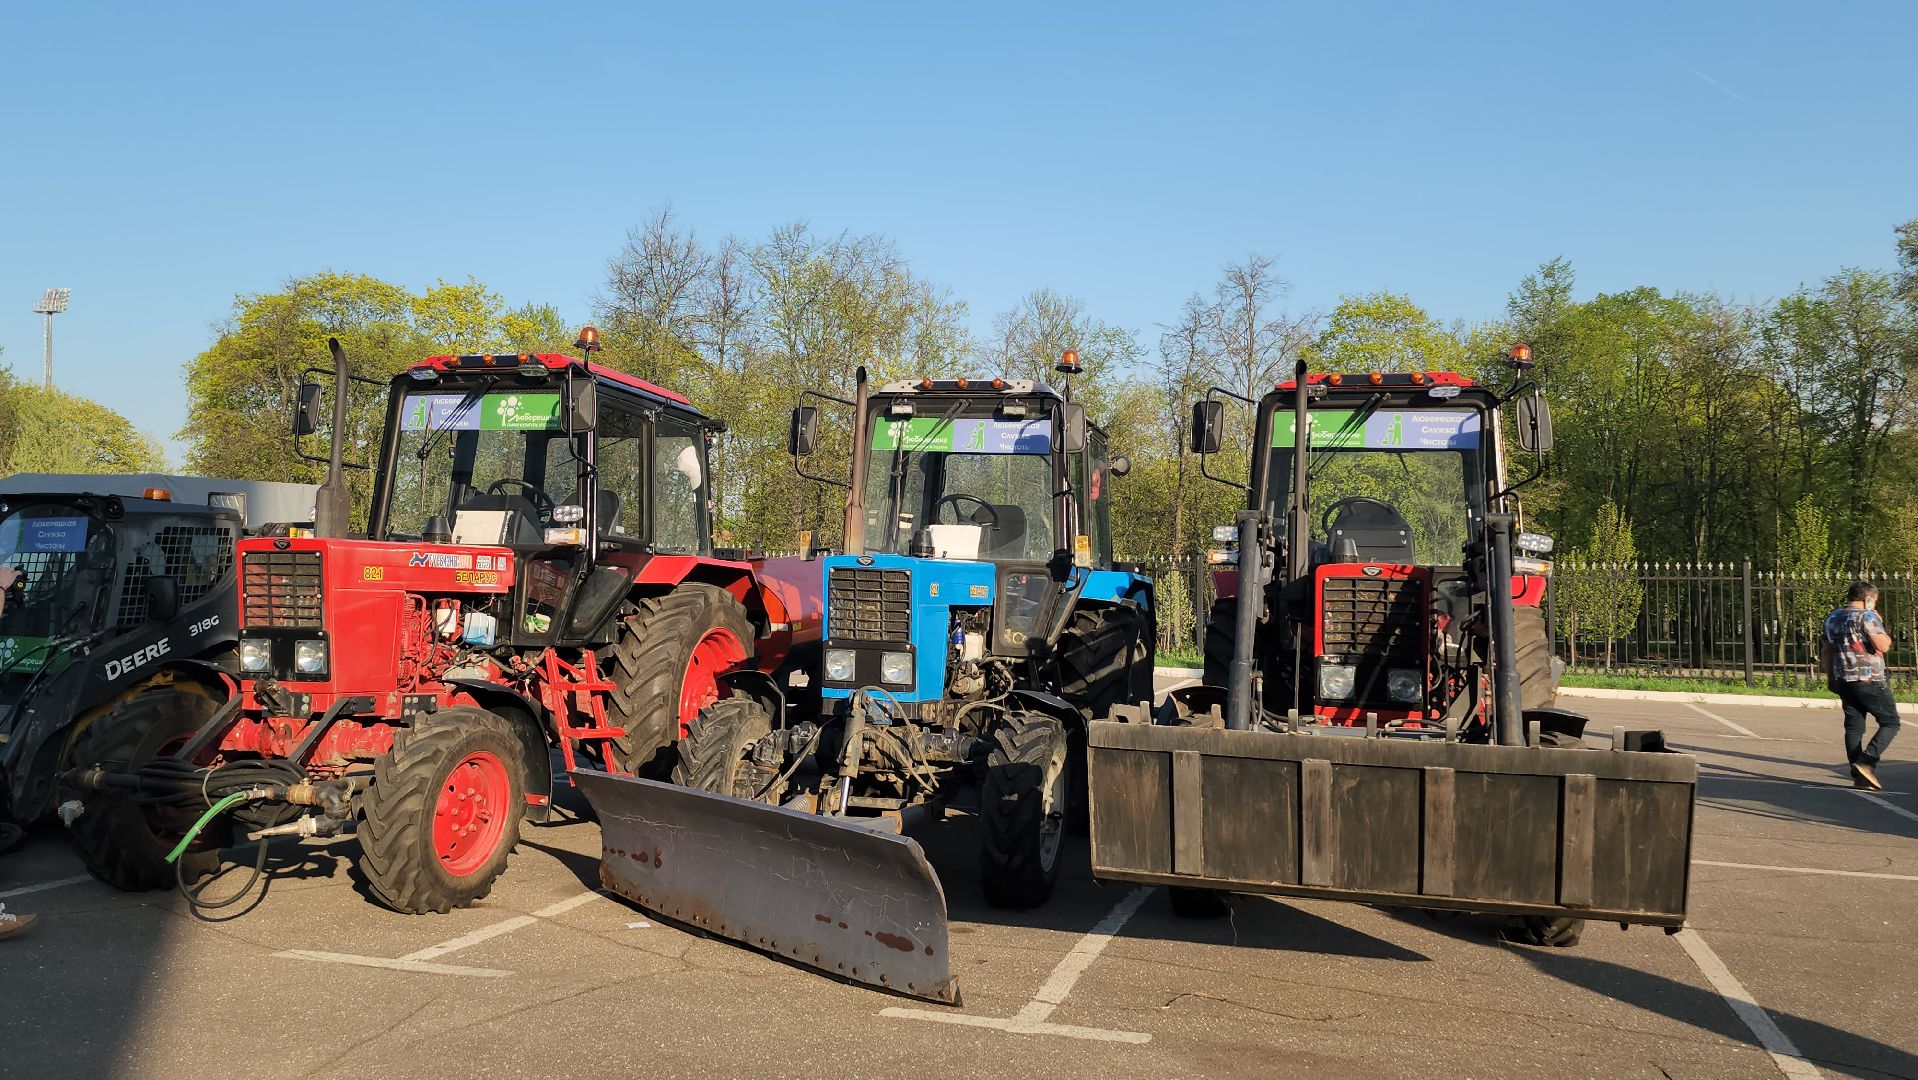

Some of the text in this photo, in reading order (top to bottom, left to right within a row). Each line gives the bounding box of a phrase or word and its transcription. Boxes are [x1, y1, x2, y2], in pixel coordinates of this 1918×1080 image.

[455, 571, 497, 583] БЕЛАРУС
[189, 615, 220, 637] 318G
[105, 637, 171, 681] DEERE
